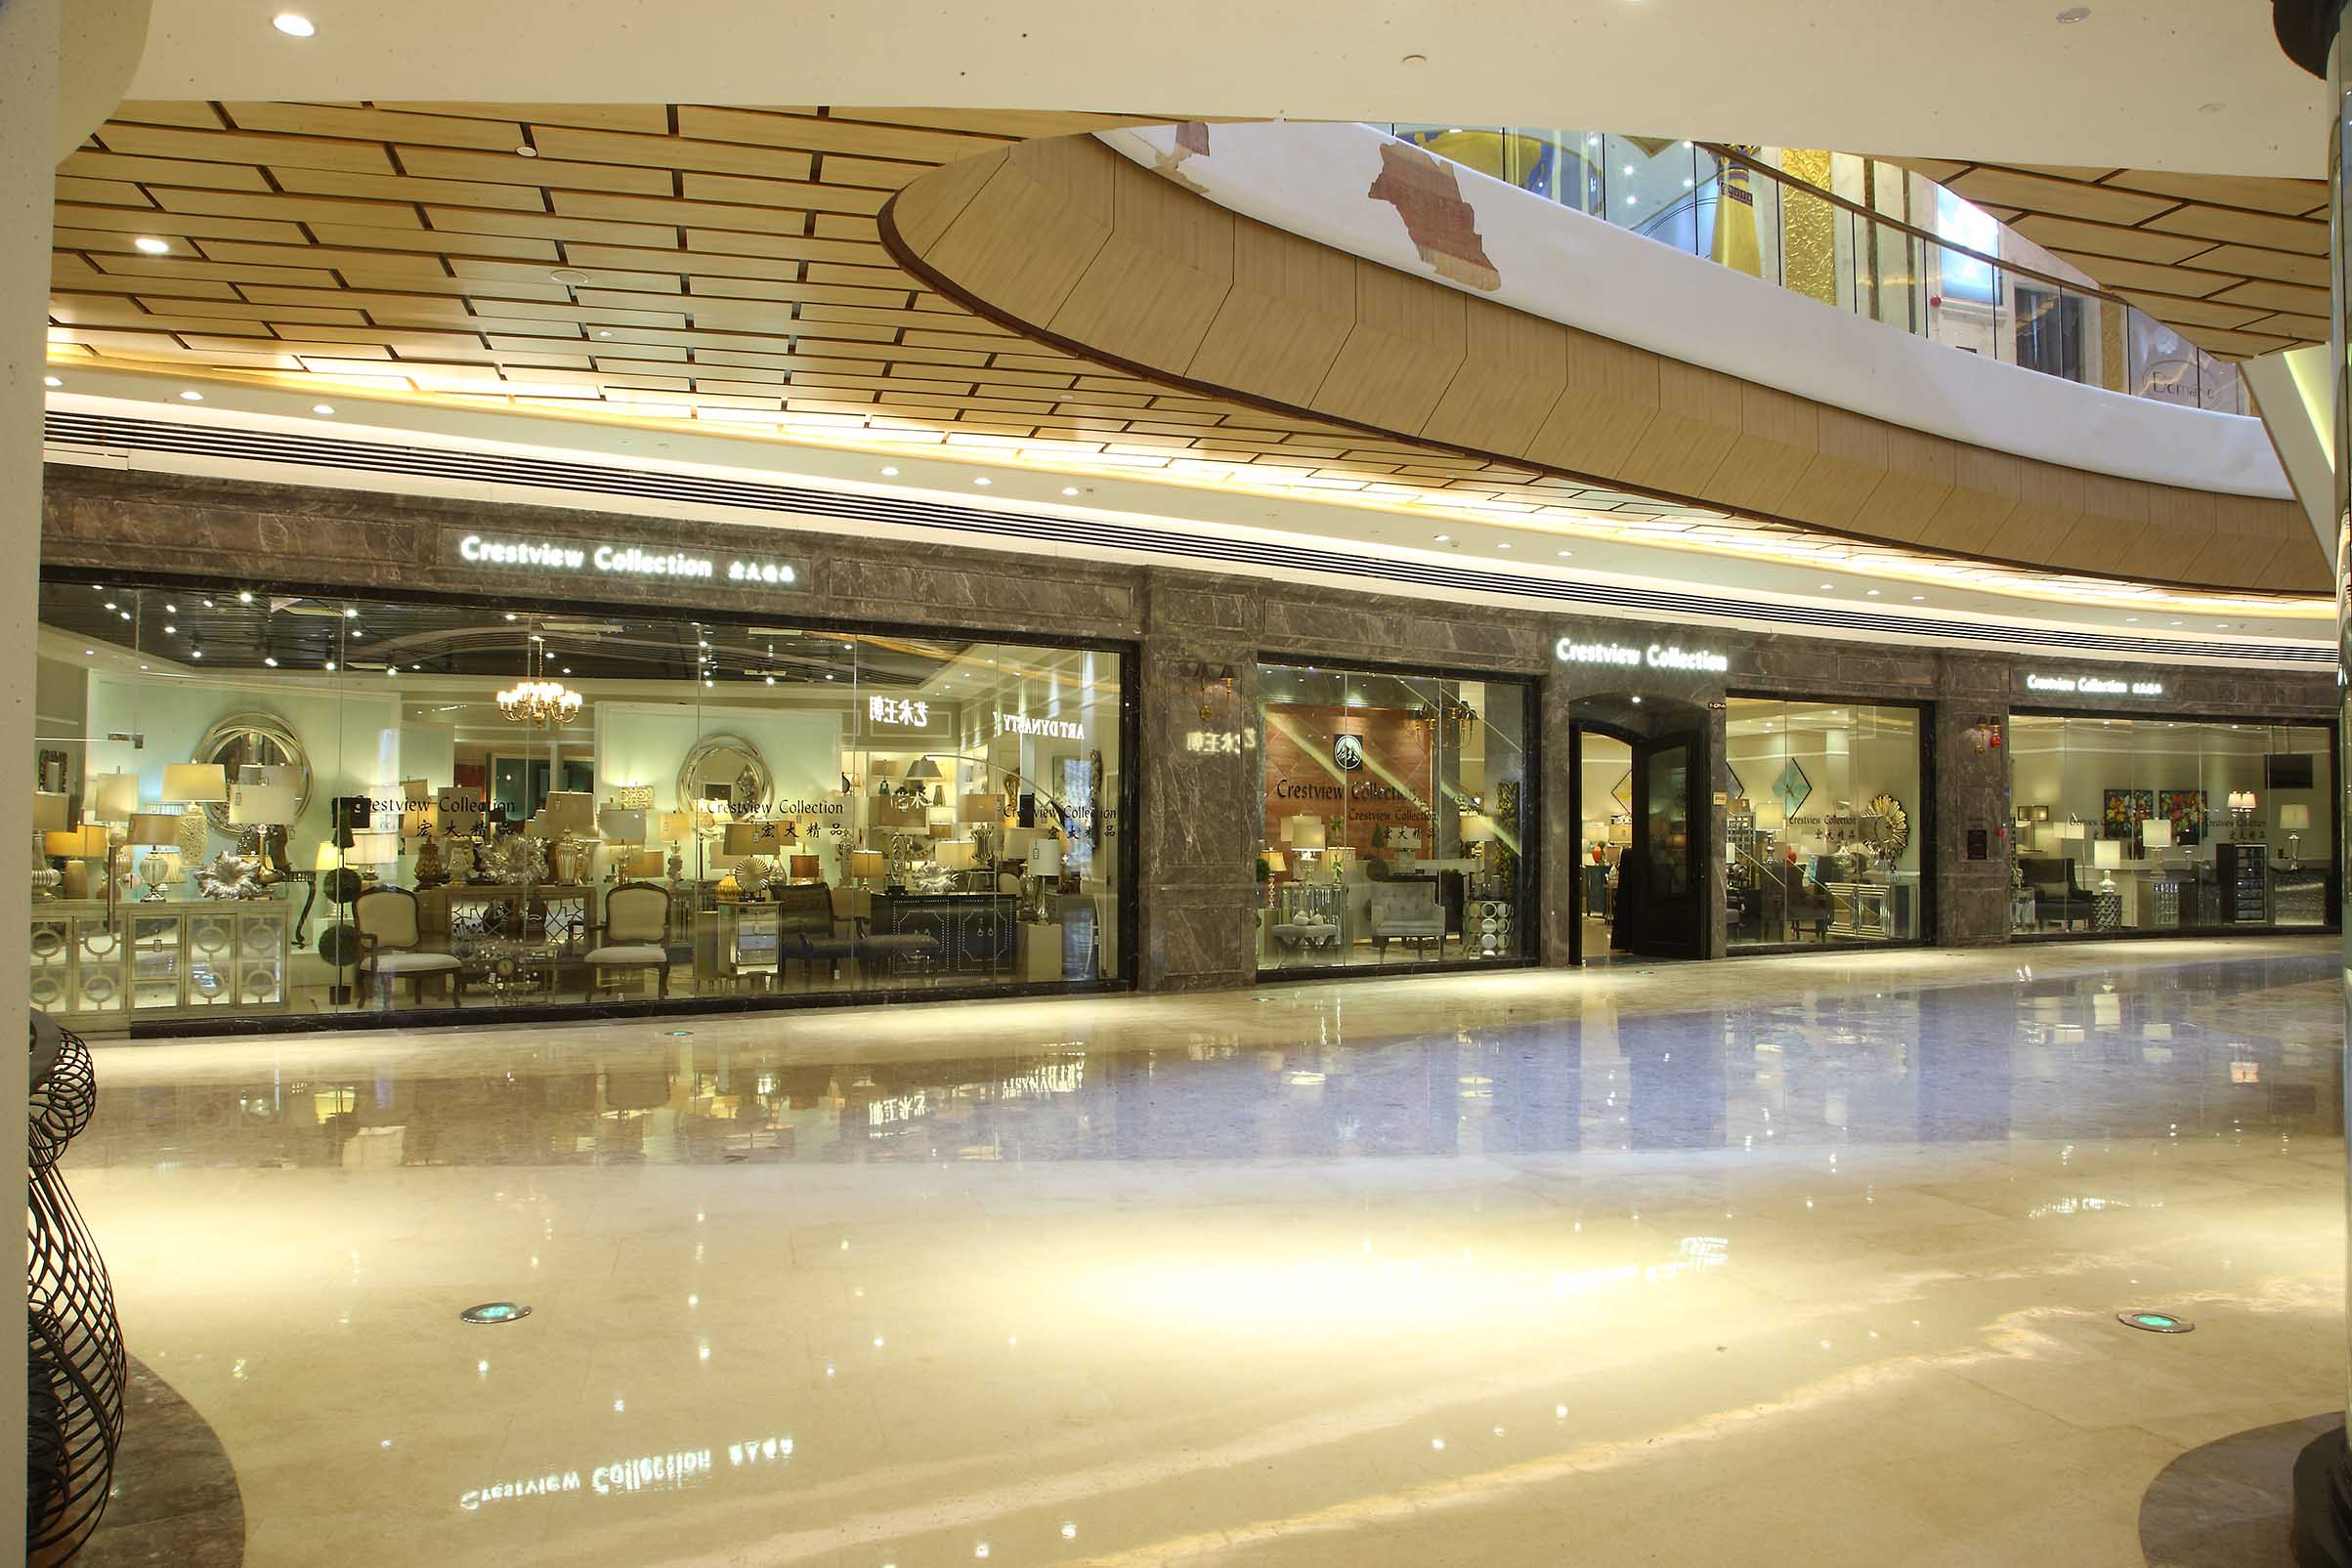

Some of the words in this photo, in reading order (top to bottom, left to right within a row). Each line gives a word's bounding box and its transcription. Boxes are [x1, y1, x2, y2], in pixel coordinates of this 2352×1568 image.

[460, 536, 584, 567] Crestview
[594, 547, 712, 577] Collection
[1557, 637, 1642, 665] Crestview
[1646, 644, 1728, 672] Collection
[1277, 780, 1345, 799] Crestview
[779, 799, 843, 814] Collection
[761, 823, 843, 838] 宏大精品
